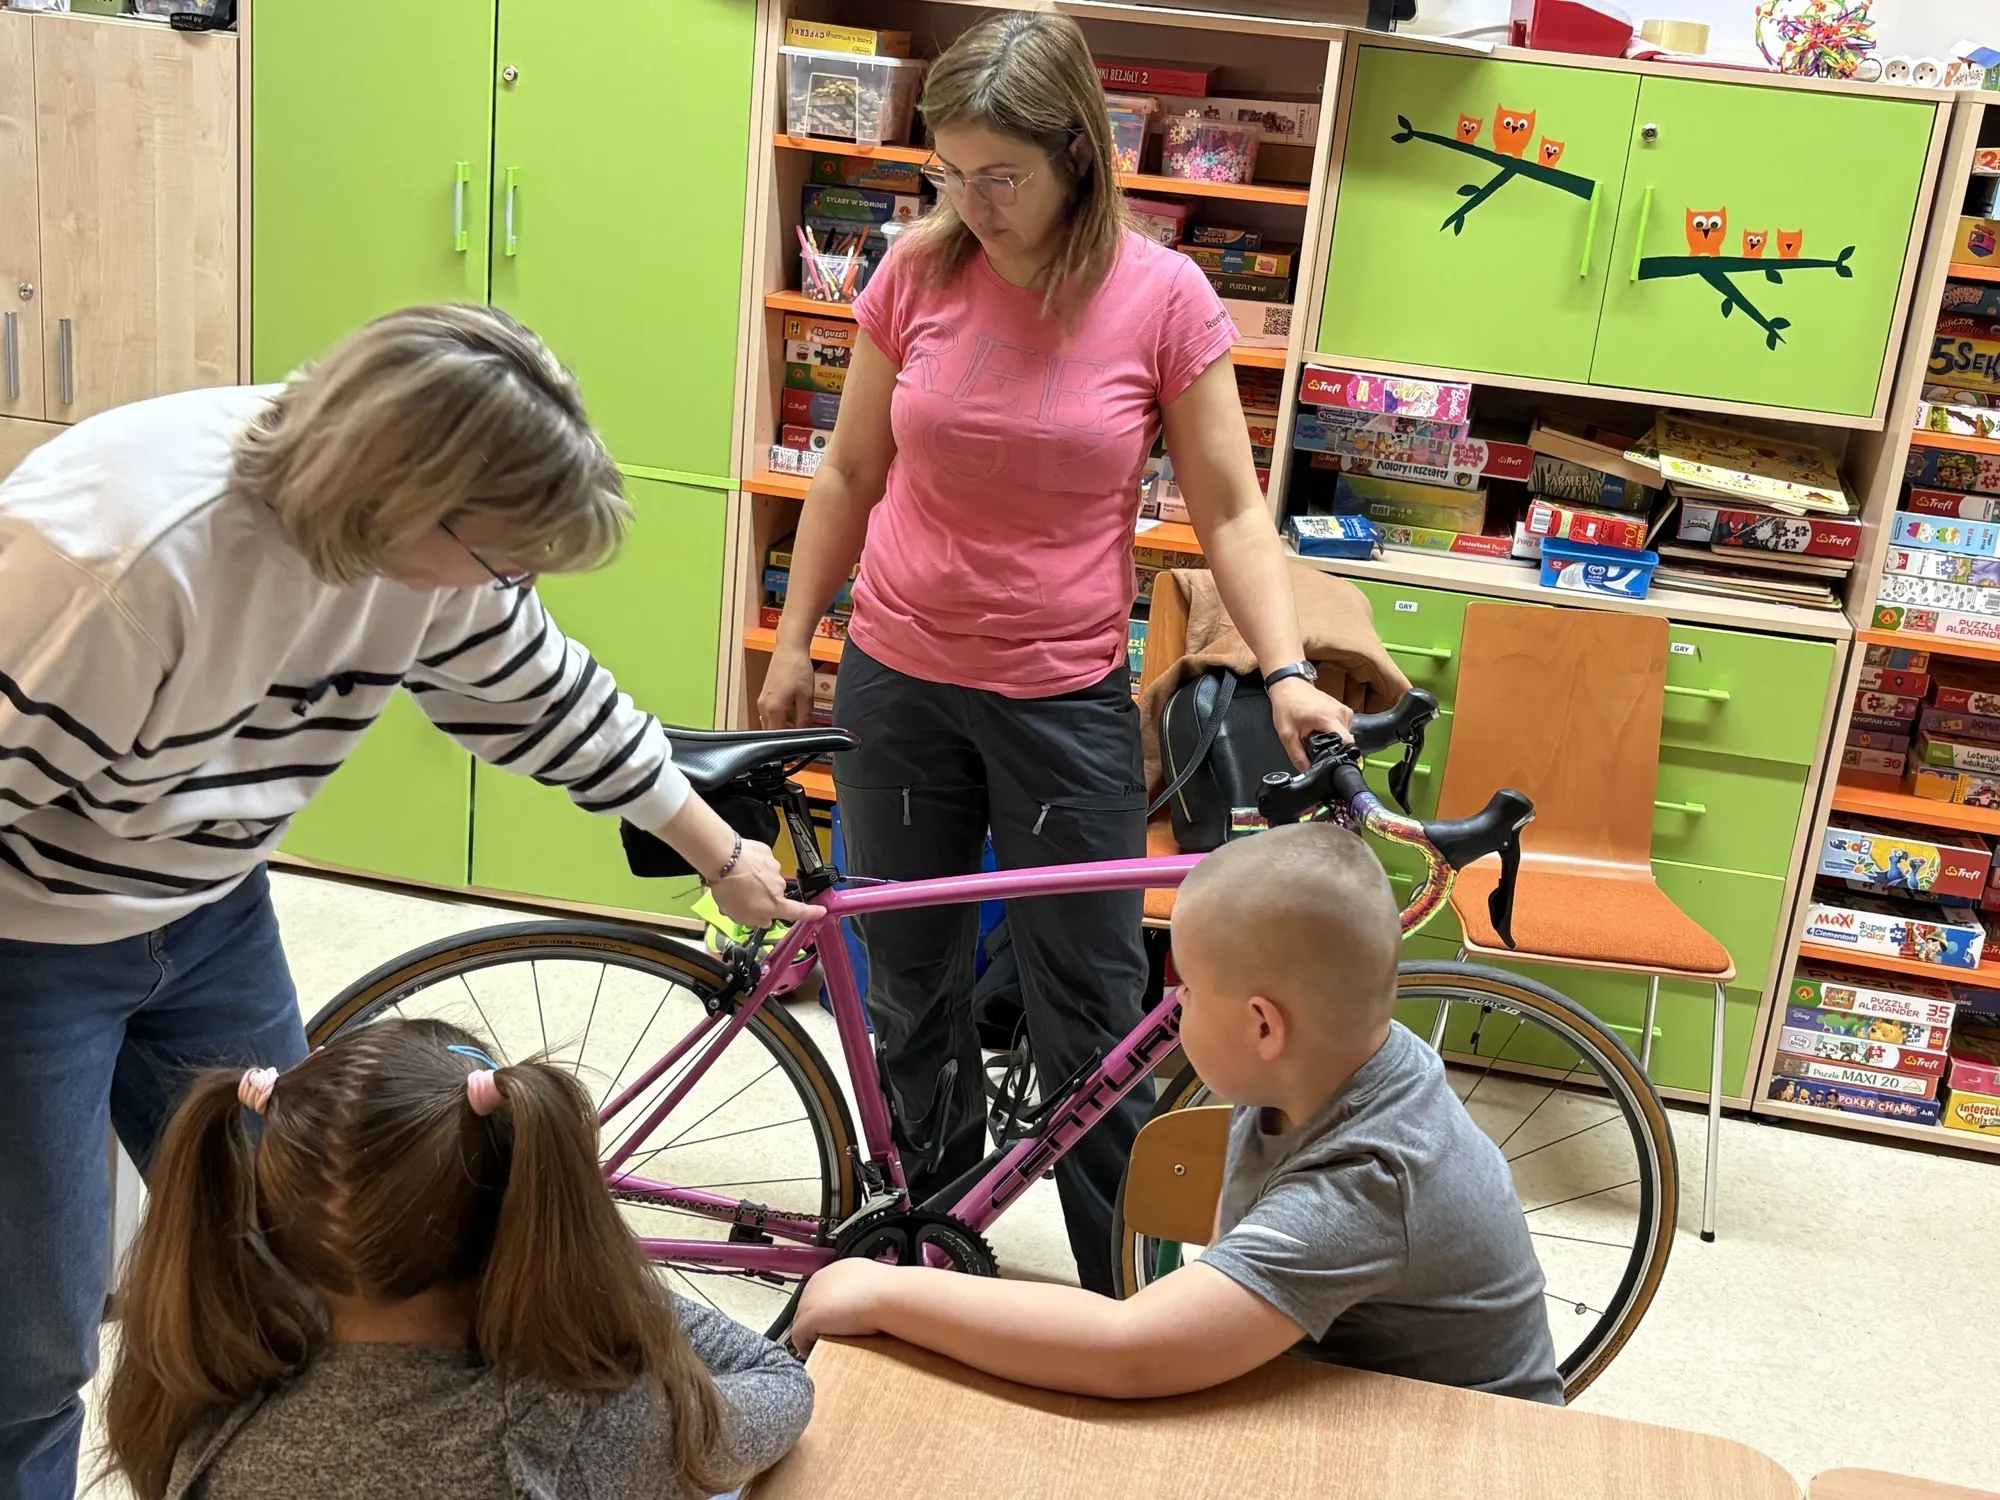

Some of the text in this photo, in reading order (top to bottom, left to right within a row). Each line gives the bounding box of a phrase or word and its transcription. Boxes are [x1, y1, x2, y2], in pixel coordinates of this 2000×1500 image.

[1141, 71, 1149, 84] 2
[826, 196, 849, 206] SYLABY
[859, 199, 888, 210] DOMINIE
[1229, 282, 1251, 290] PUZZLE
[812, 326, 849, 340] 48 puzzli
[1319, 381, 1342, 394] Trefl
[1449, 388, 1466, 420] Barbie
[1376, 460, 1408, 475] Kolory
[1506, 457, 1522, 466] Trefl
[1545, 473, 1590, 487] FARMER
[1928, 498, 1953, 511] Trefl
[1621, 523, 1637, 547] 104
[1828, 535, 1851, 546] Trefl
[1458, 539, 1491, 549] Castorland
[1674, 645, 1690, 653] GRY
[1882, 758, 1901, 769] 30
[1957, 867, 1981, 881] Trefl
[1859, 921, 1888, 933] Super
[1814, 927, 1857, 943] Clementoni
[1859, 931, 1886, 941] Color
[1807, 969, 1915, 992] Puzzle
[1468, 997, 1500, 1009] SWISS
[1858, 1001, 1920, 1018] ALEXANDER
[1870, 996, 1912, 1010] PUZZLE
[1926, 1003, 1952, 1019] 35
[1791, 1009, 1811, 1021] Disney
[1926, 1016, 1948, 1025] maxi
[1916, 1057, 1939, 1069] Trefl
[1813, 1067, 1900, 1089] Puzzle MAXI 20
[1838, 1095, 1876, 1108] POKER
[1878, 1101, 1917, 1116] CHAMP
[1965, 1113, 1988, 1126] Quiz
